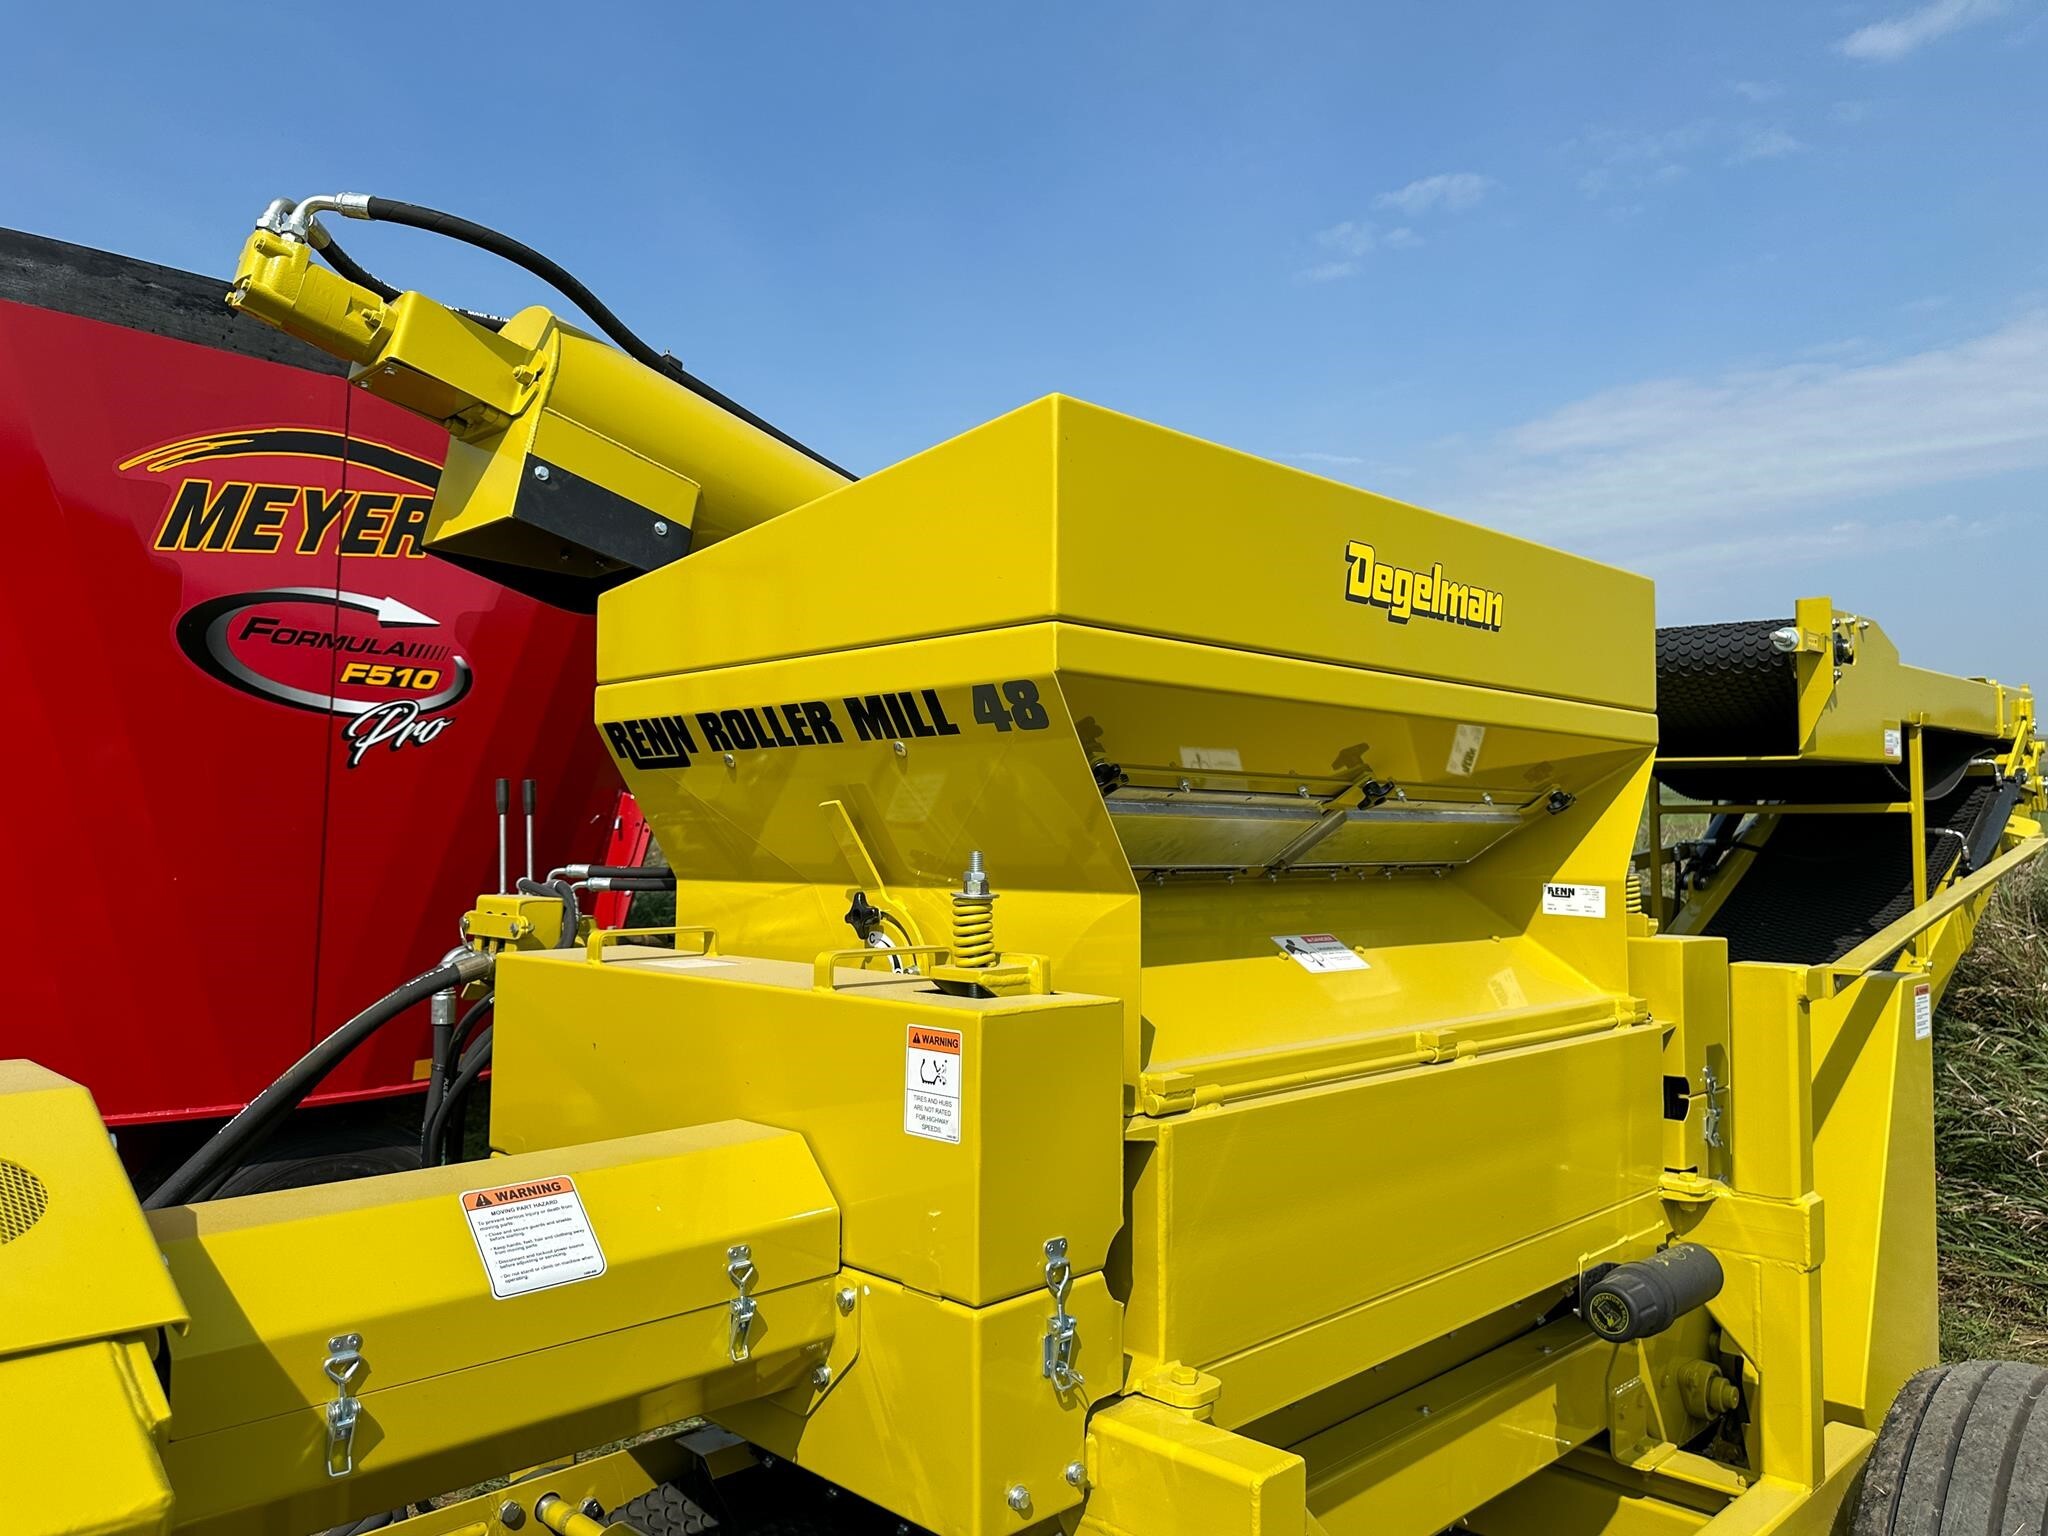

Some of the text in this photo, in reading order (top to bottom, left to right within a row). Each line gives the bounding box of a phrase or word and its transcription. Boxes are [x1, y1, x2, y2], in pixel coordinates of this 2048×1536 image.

[154, 478, 434, 557] MEYER
[1345, 540, 1503, 632] Degelman
[239, 616, 408, 657] FORMULA
[340, 661, 444, 691] F510
[342, 699, 455, 768] Pro
[603, 680, 1050, 770] RENN ROLLER MILL 48
[1548, 887, 1575, 898] RENN
[870, 933, 875, 943] C
[922, 1035, 958, 1048] WARNING
[927, 1116, 949, 1125] HIGHWAY
[935, 1108, 951, 1116] RATED
[495, 1182, 561, 1201] WARNING
[491, 1208, 515, 1216] MOVING
[533, 1200, 558, 1208] HAZARD
[499, 1256, 525, 1264] Disconnect
